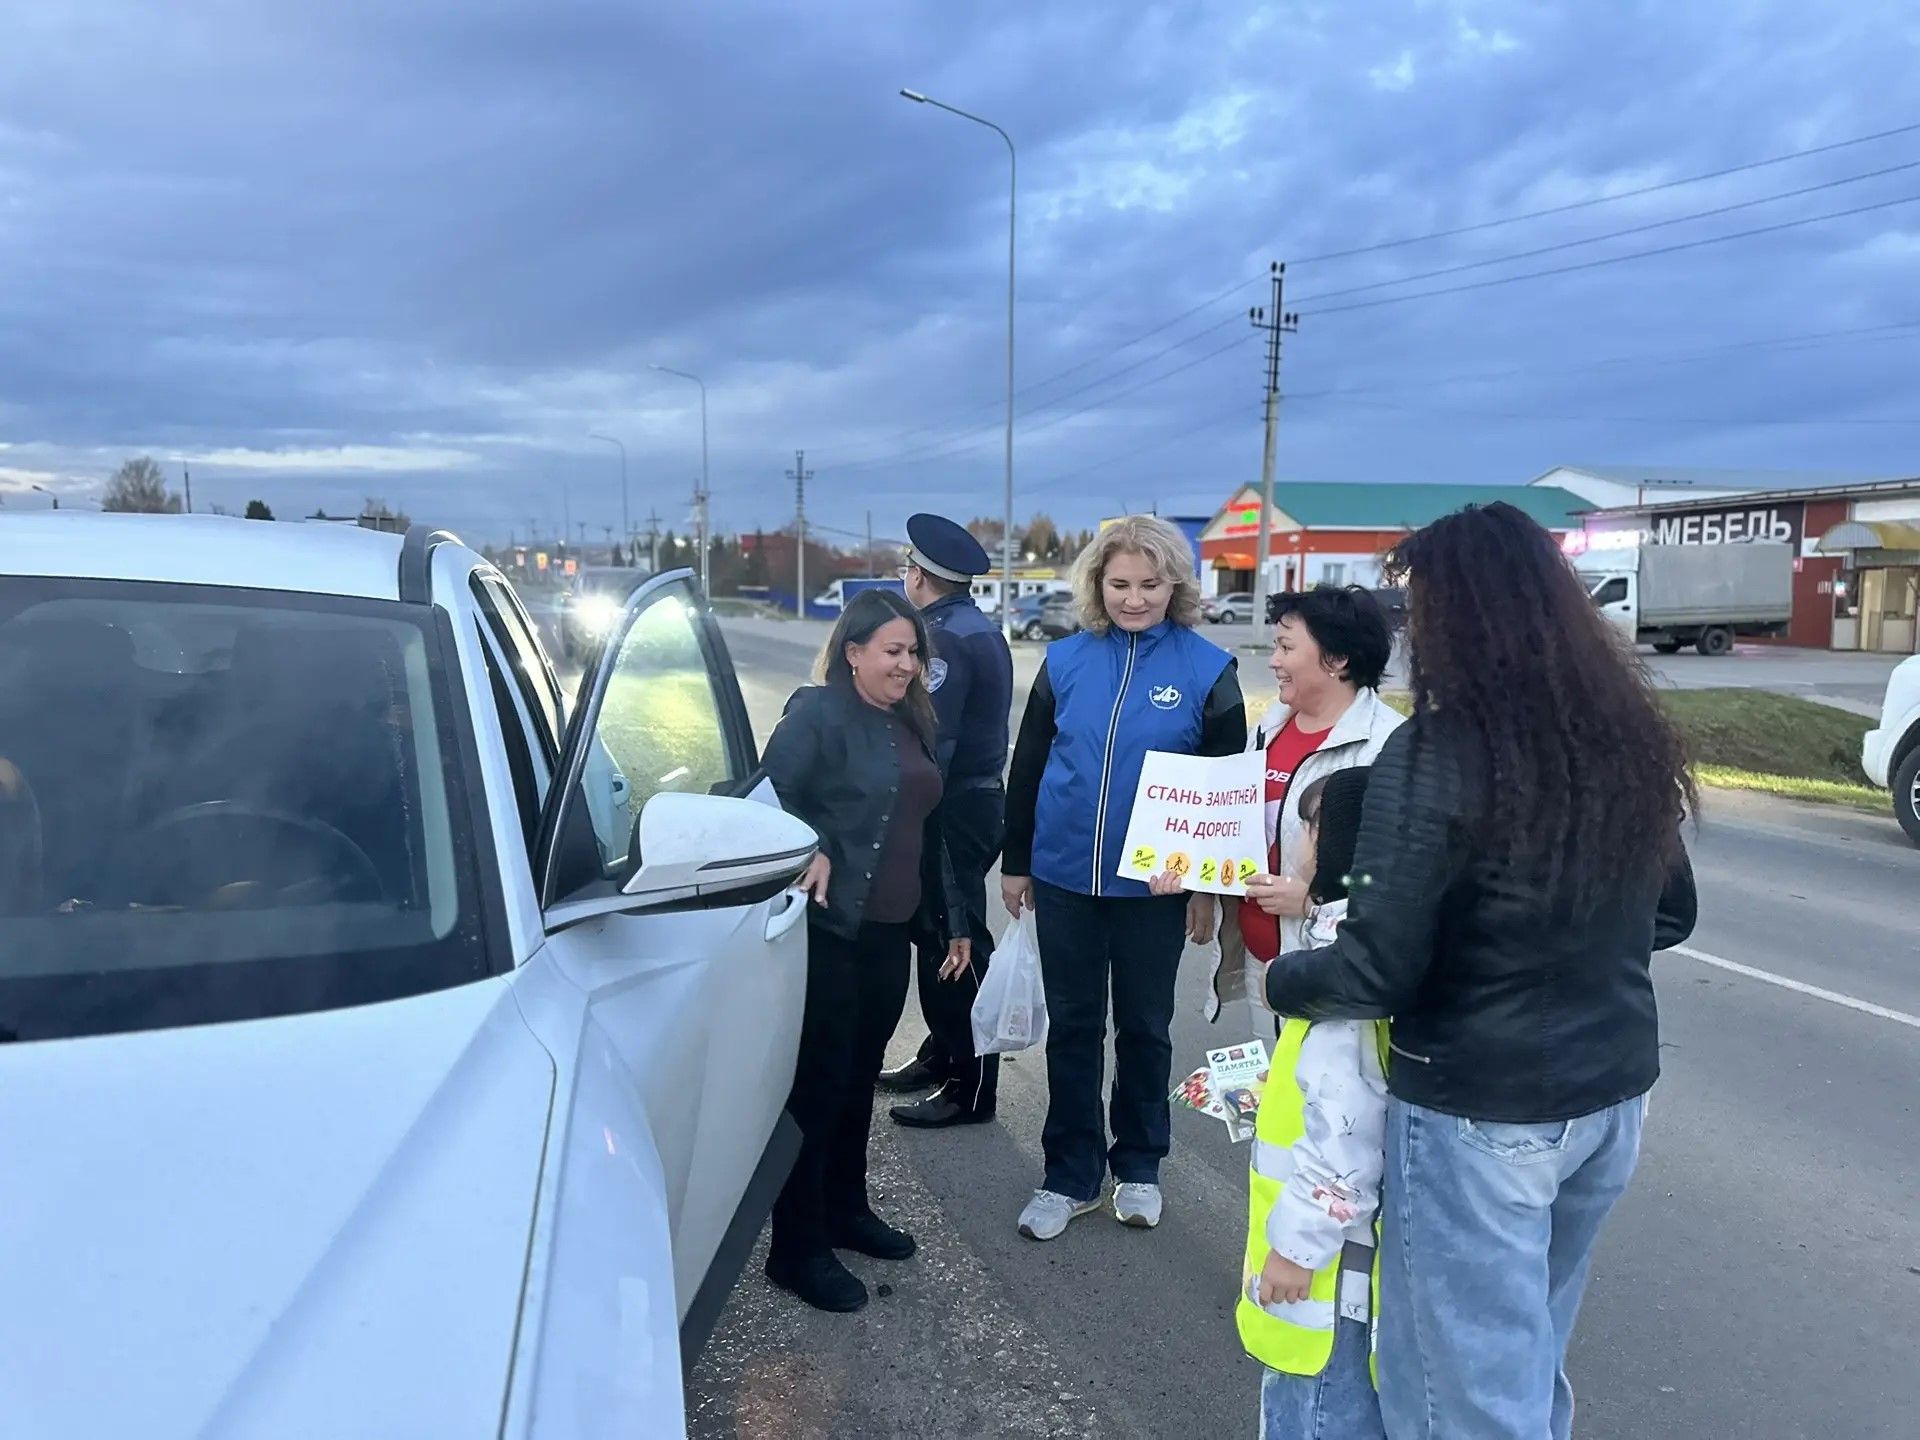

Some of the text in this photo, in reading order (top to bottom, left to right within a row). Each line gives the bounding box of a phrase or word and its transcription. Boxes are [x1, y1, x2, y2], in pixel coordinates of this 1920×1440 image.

[1659, 510, 1792, 545] МЕБЕЛЬ
[1147, 784, 1257, 806] СТАНЬ ЗАМЕТНЕЙ
[1165, 817, 1241, 839] НА ДОРОГЕ!
[1217, 1059, 1263, 1072] ПАМЯТКА
